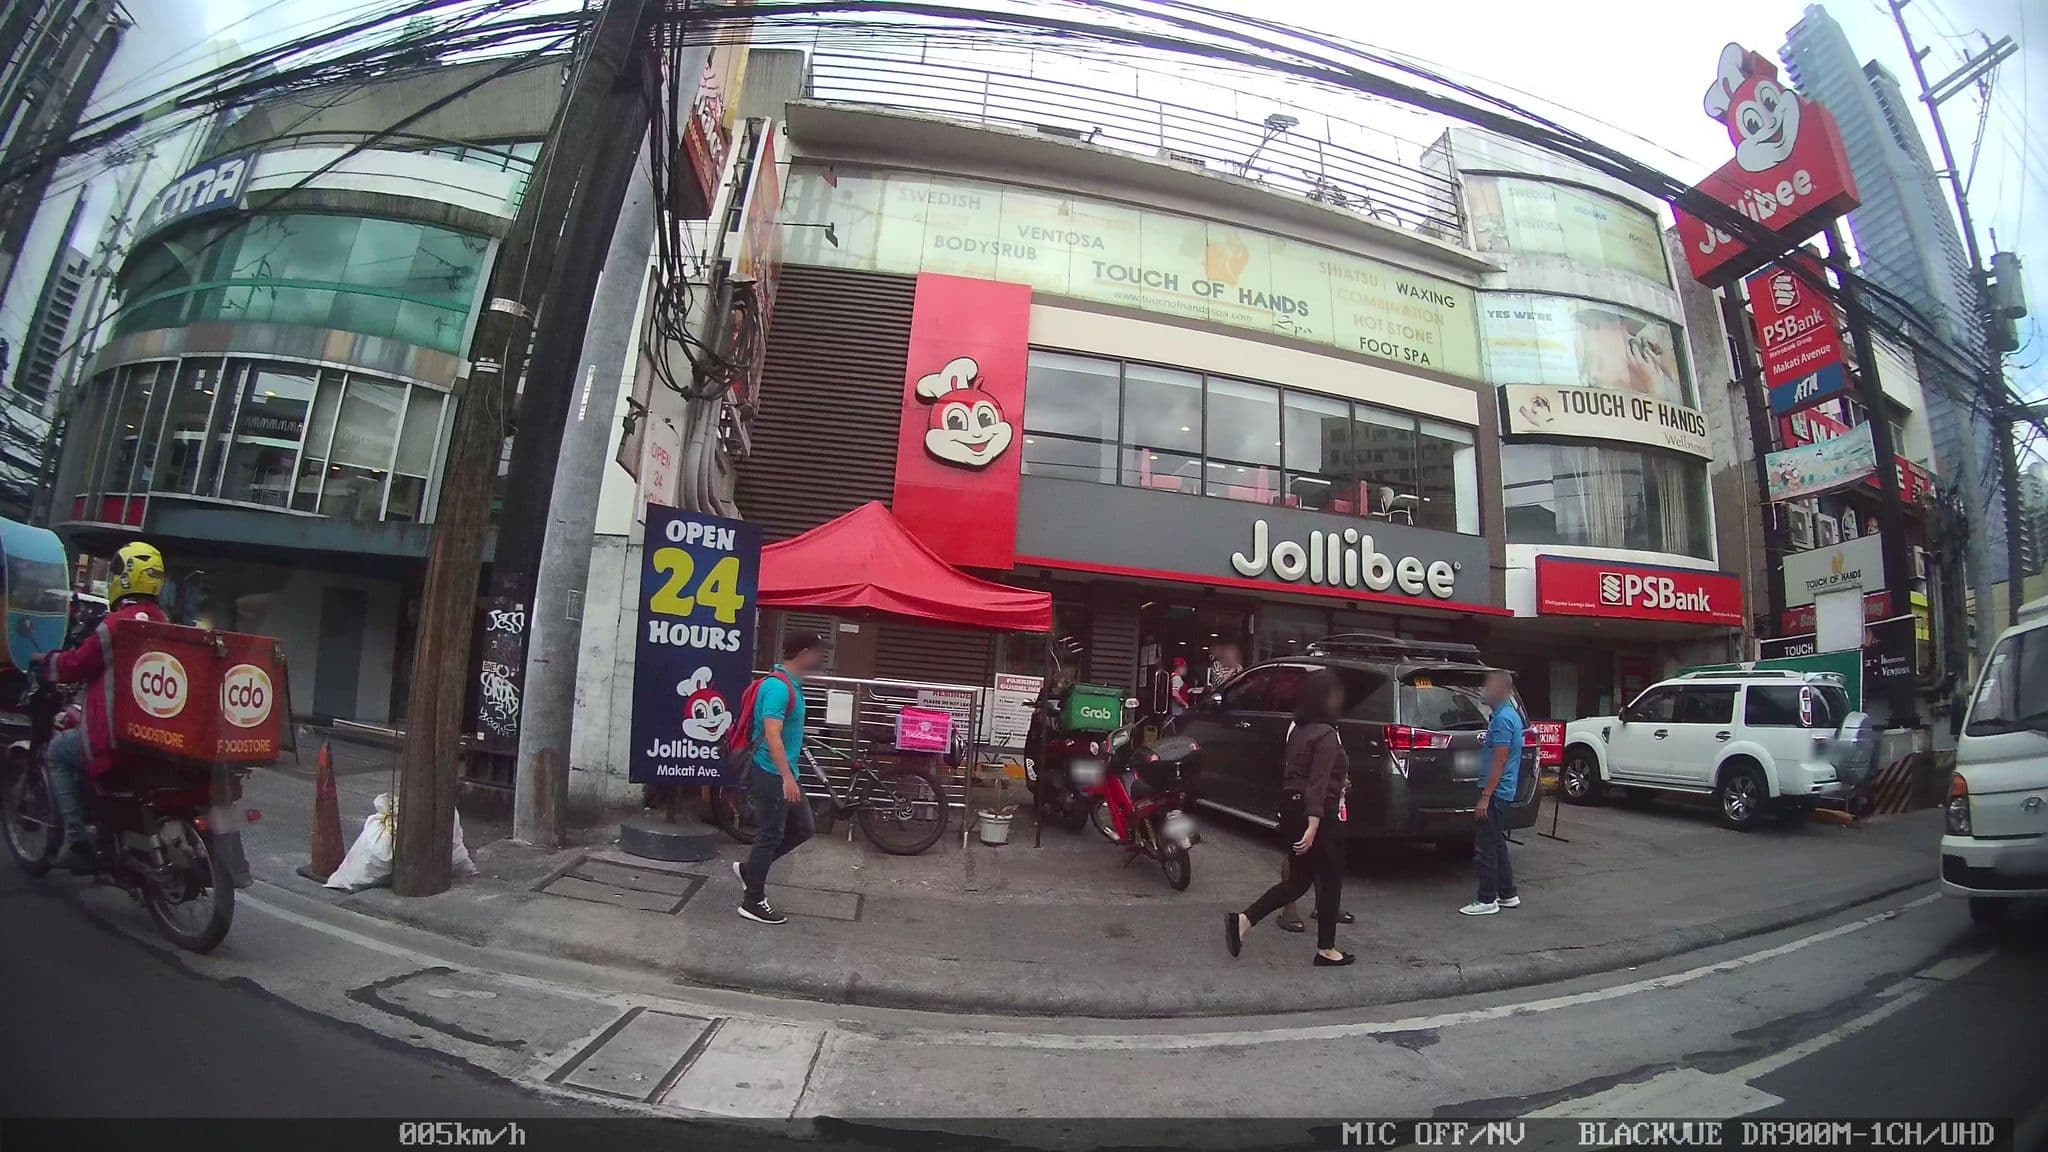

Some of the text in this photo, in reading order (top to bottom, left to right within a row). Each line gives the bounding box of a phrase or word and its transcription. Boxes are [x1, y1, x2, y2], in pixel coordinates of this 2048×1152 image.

[900, 187, 981, 210] SWEDISH
[934, 235, 1037, 260] BODYSRUB
[1017, 223, 1104, 250] VENTOSA
[1092, 260, 1309, 317] TOUCH OF HANDS
[1319, 262, 1378, 287] SHIATSU
[1396, 281, 1456, 309] WAXING
[1354, 313, 1434, 345] HOT STONE
[1487, 310, 1510, 319] YES
[1763, 308, 1824, 347] PSBank
[1360, 336, 1431, 366] FOOT SPA
[1772, 344, 1832, 375] Makati Avenue
[1794, 372, 1818, 403] ATM
[1558, 390, 1707, 438] TOUCH OF HANDS
[665, 519, 736, 551] OPEN
[1231, 519, 1455, 599] Jollibee
[650, 547, 745, 624] 24
[1625, 573, 1711, 612] PSBank
[649, 620, 741, 652] HOURS
[1784, 643, 1814, 656] TOUCH
[140, 665, 178, 699] cdo
[228, 678, 264, 708] cdo
[1000, 684, 1041, 692] GUIDELINE
[1006, 678, 1041, 686] PARKING
[1080, 705, 1111, 720] Grab
[127, 722, 185, 748] FOODSTORE
[656, 764, 721, 778] Makati Ave.
